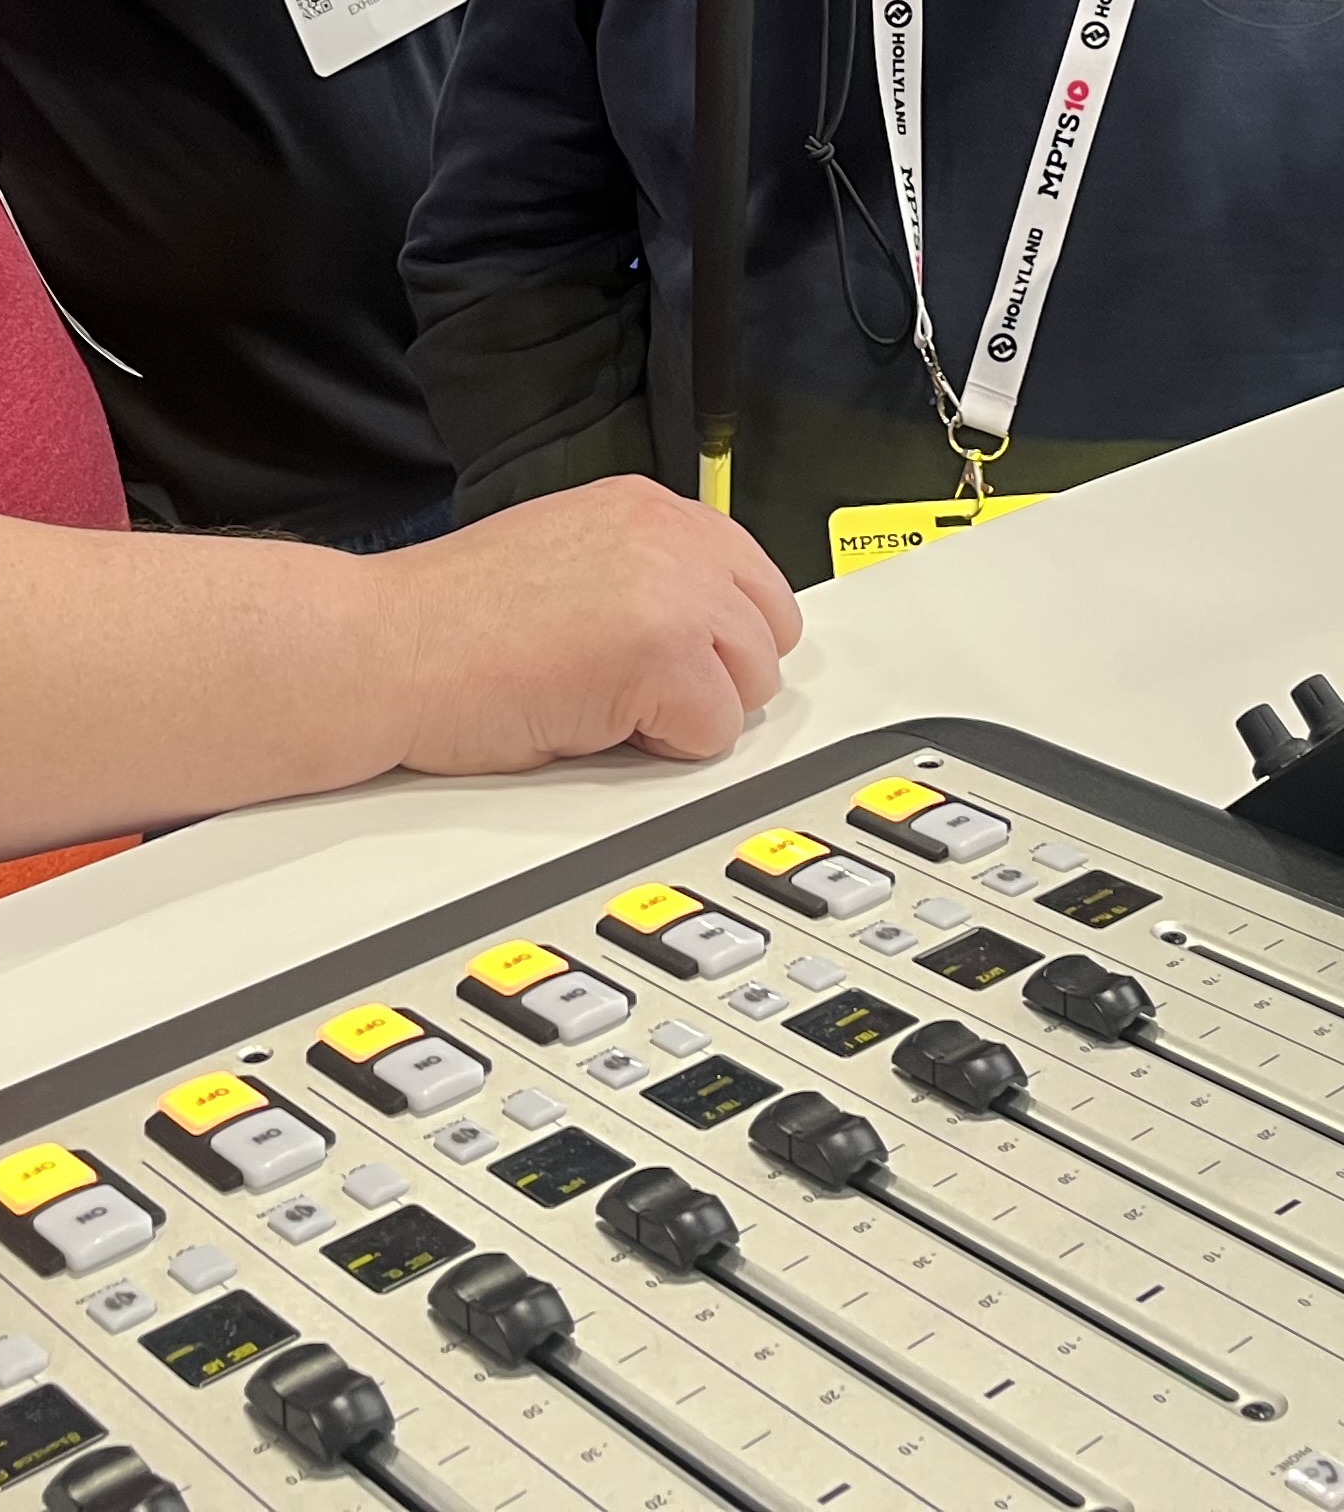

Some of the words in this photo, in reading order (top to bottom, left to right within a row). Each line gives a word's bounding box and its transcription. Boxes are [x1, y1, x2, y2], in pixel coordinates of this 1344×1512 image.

[891, 32, 907, 136] HOLLYLAND
[1038, 80, 1090, 199] MPTS10
[1001, 227, 1044, 330] HOLLYLAND
[839, 532, 924, 552] MPTS10
[560, 987, 588, 1002] ON
[355, 1019, 386, 1036] OFF
[414, 1054, 442, 1071] ON
[195, 1087, 231, 1106] OFF
[251, 1126, 283, 1145] ON
[19, 1160, 57, 1181] OFF
[75, 1205, 108, 1226] ON
